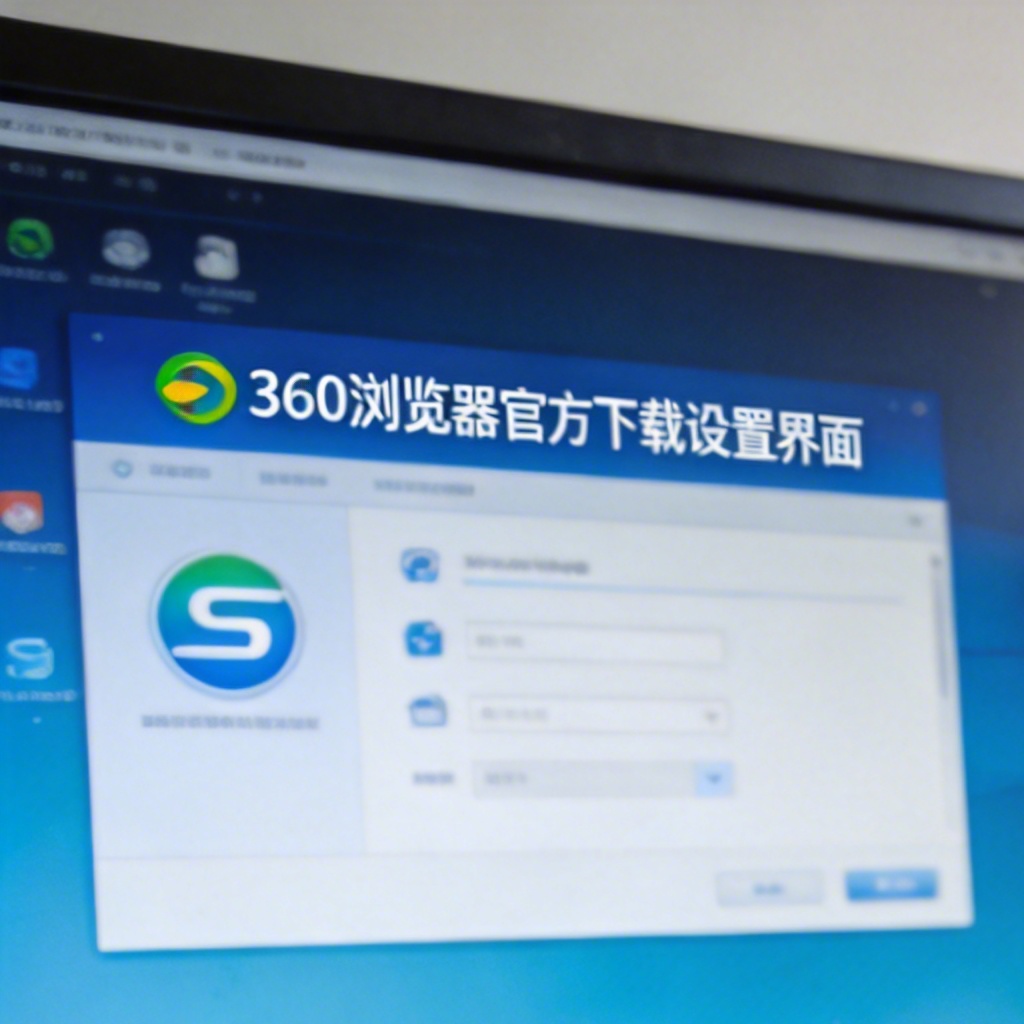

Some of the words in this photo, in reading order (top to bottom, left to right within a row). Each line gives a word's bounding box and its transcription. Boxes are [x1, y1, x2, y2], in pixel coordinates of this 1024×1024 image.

[248, 368, 864, 470] 360浏览器官方下载设置界面
